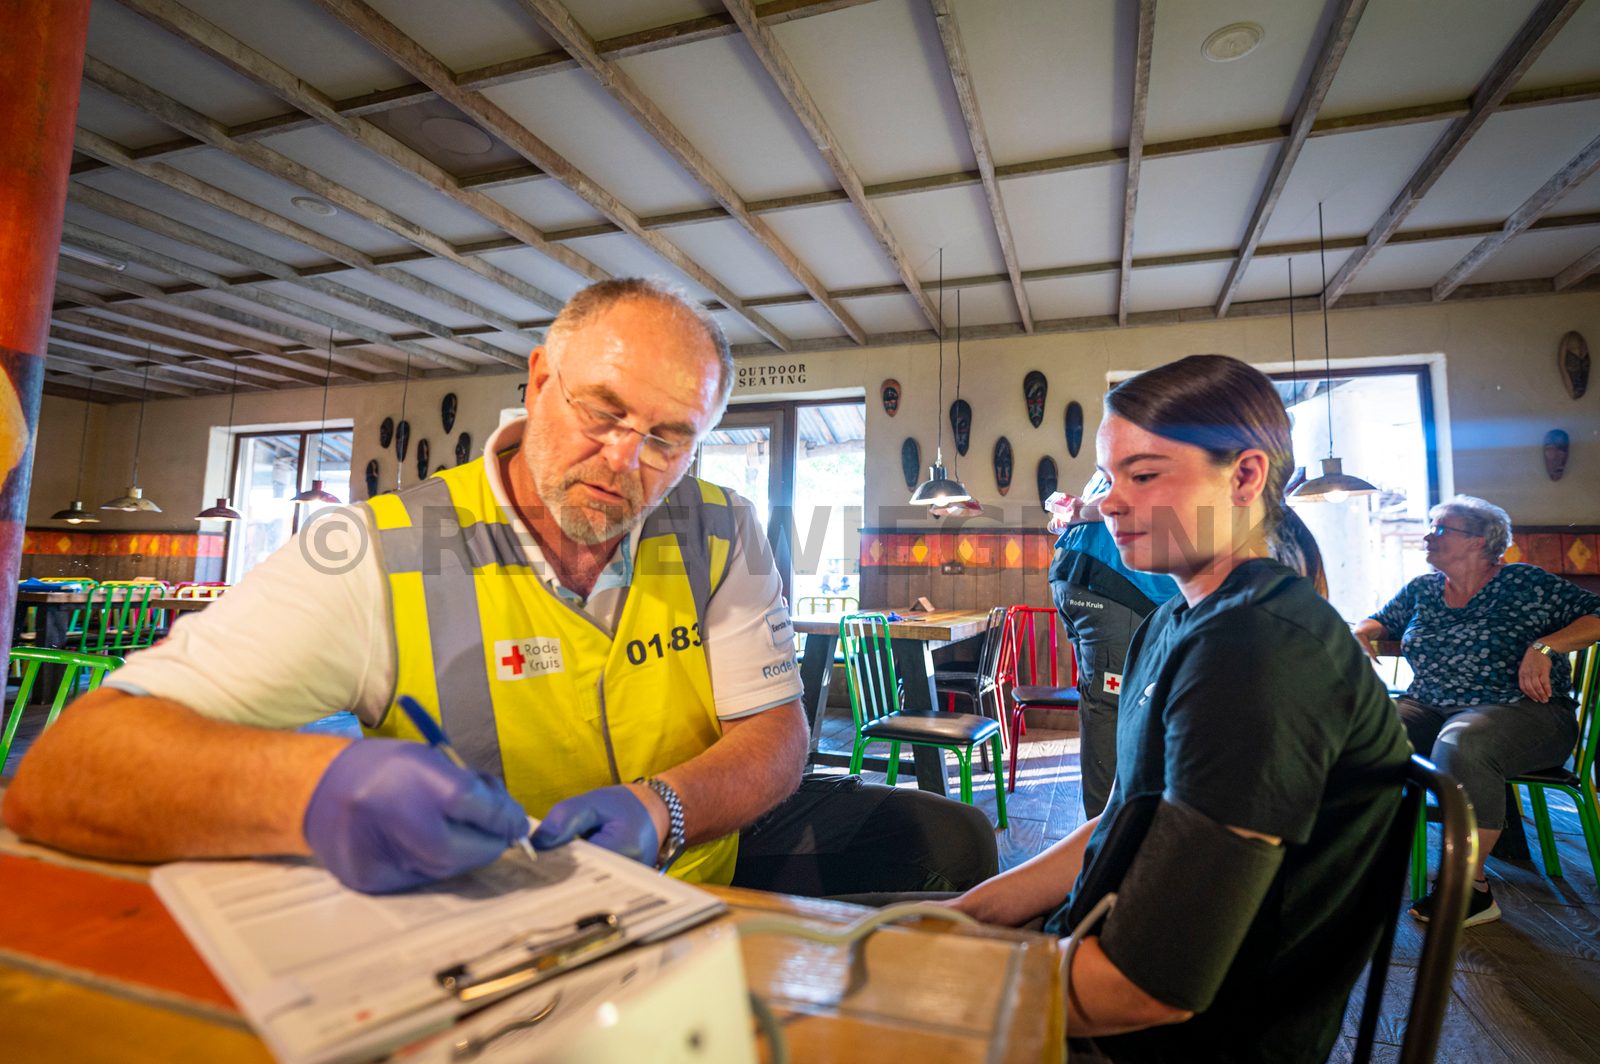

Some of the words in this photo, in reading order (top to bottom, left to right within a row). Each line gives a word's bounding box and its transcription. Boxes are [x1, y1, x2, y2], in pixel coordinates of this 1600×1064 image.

[739, 363, 806, 377] OUTDOOR
[738, 375, 806, 387] SEATING
[1069, 599, 1084, 607] Rode
[1085, 601, 1104, 609] Kruis
[524, 640, 559, 657] Rode
[529, 656, 561, 672] Kruis
[762, 660, 792, 679] Rode
